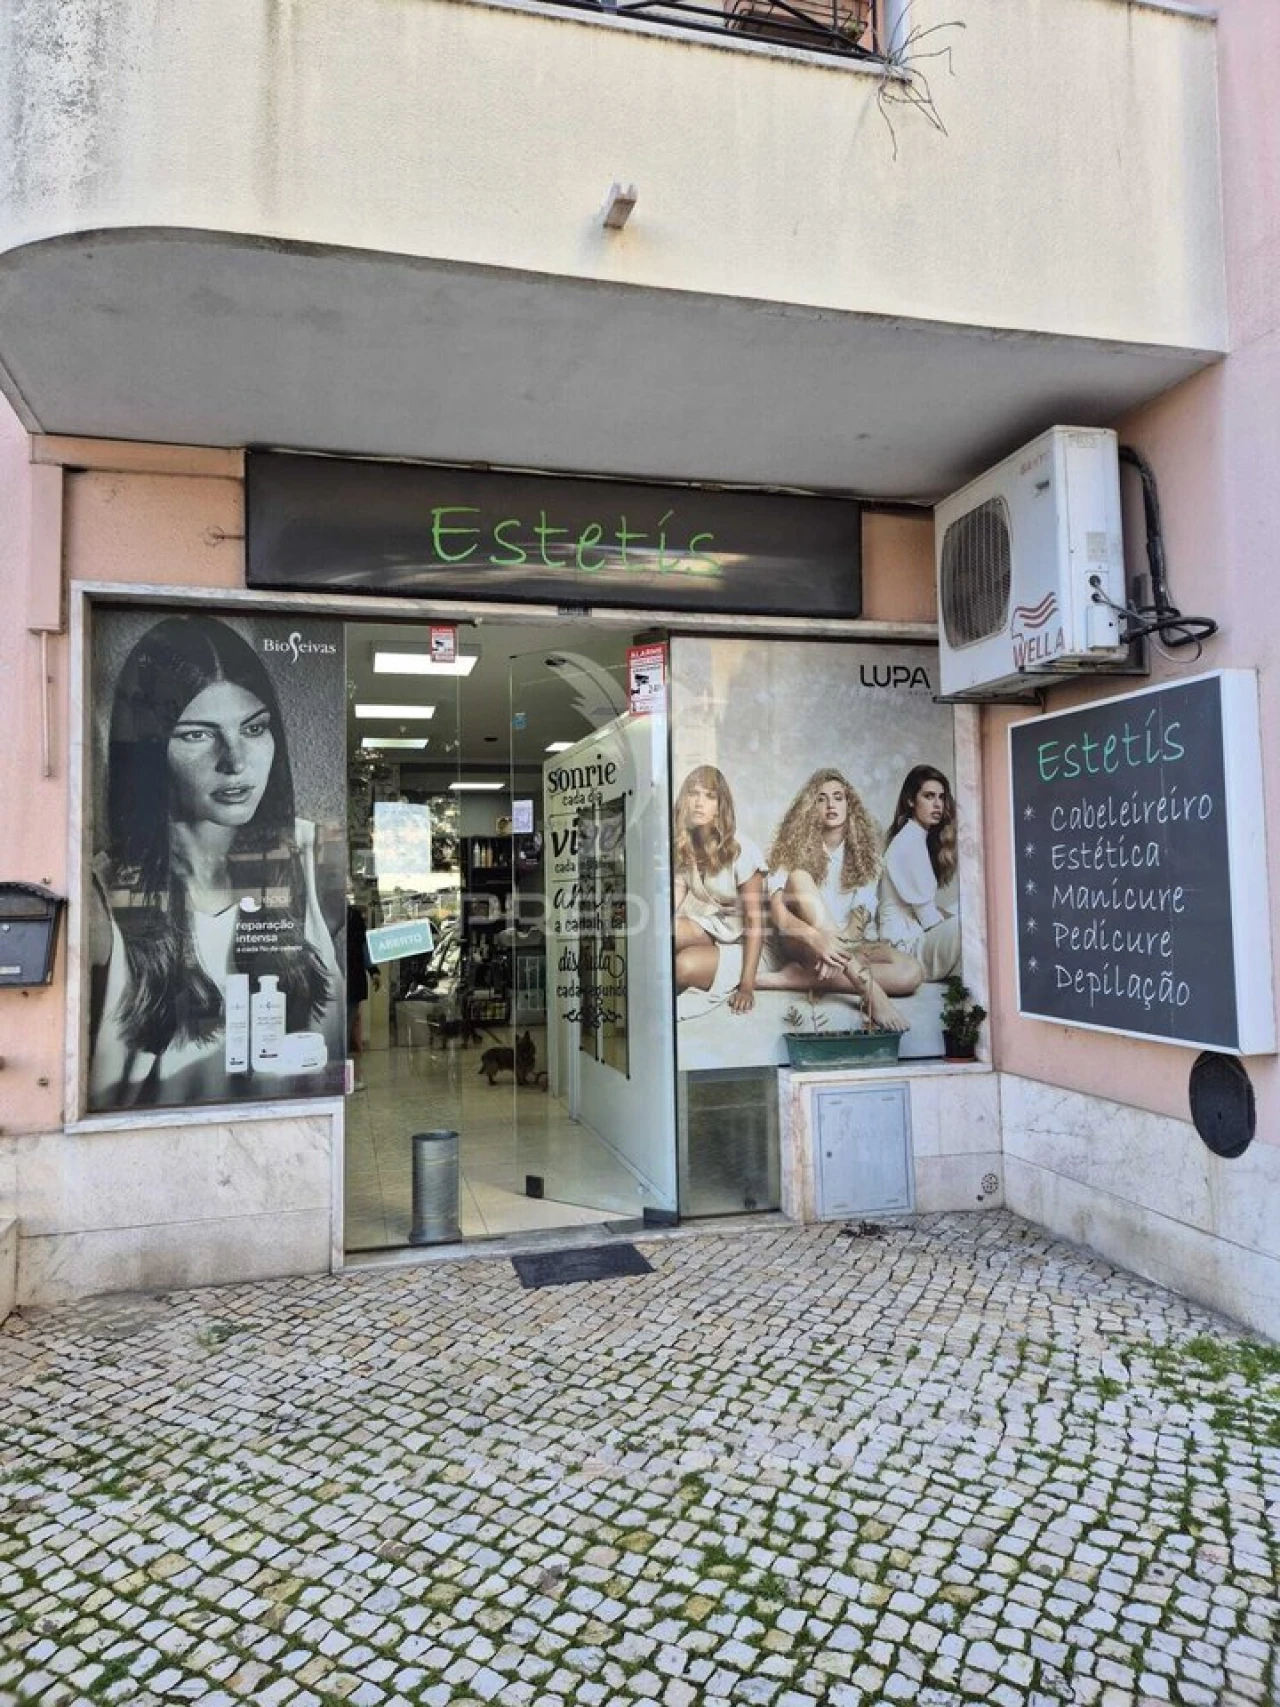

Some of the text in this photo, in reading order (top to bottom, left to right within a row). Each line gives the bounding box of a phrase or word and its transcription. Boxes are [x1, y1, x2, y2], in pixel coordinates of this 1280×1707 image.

[1012, 626, 1065, 668] WELLA
[859, 664, 931, 689] LUPA
[547, 753, 617, 794] sonrie
[1051, 835, 1160, 870] Estética
[236, 919, 294, 932] reparação
[236, 933, 278, 943] intensa
[1054, 962, 1190, 1010] Depilação
